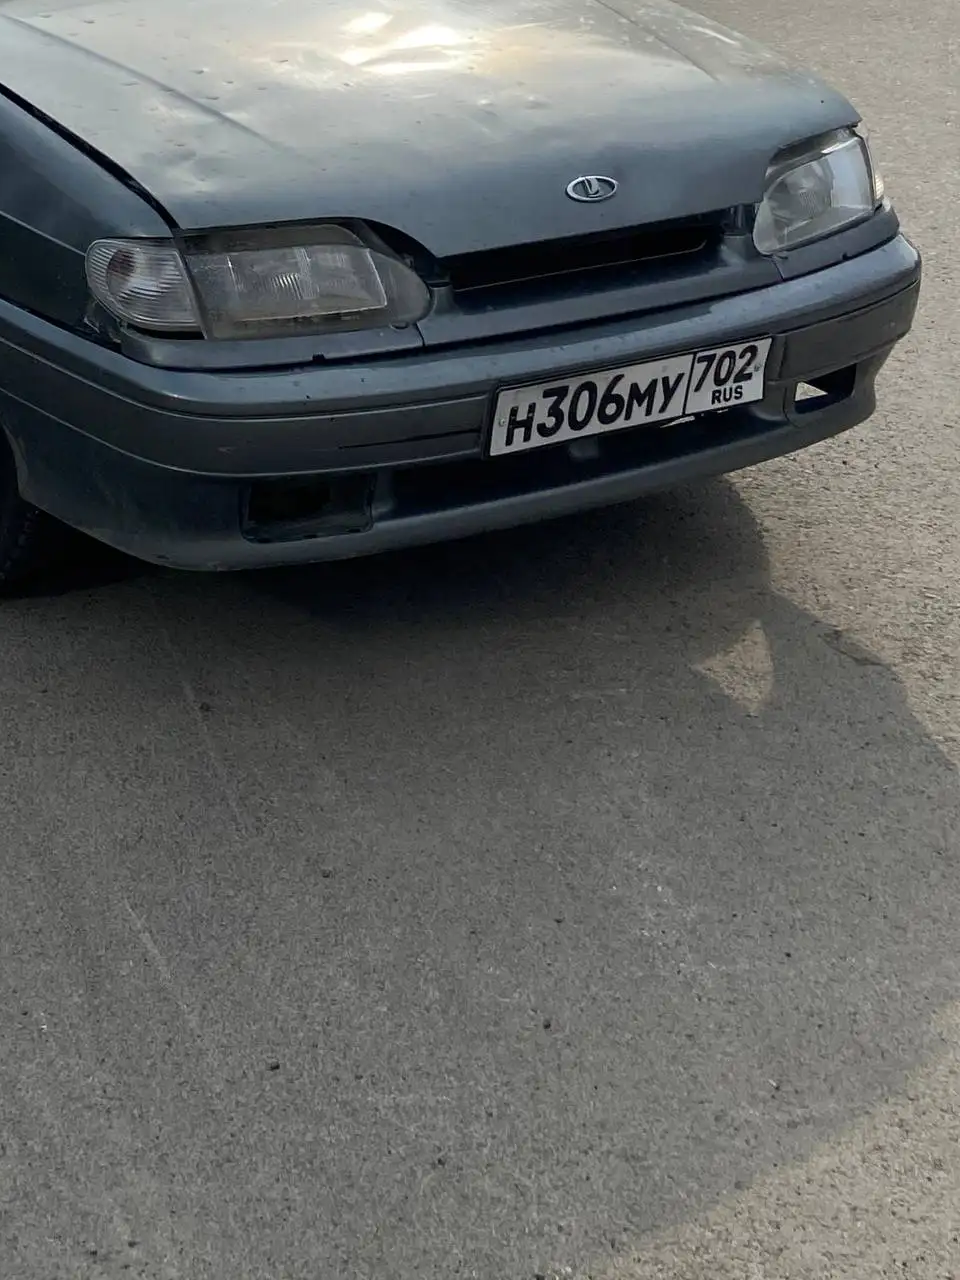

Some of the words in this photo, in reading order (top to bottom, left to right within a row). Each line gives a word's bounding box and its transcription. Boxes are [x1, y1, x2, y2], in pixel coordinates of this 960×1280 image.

[504, 372, 686, 447] Н306МУ
[693, 343, 758, 393] 702
[710, 384, 744, 406] RUS
